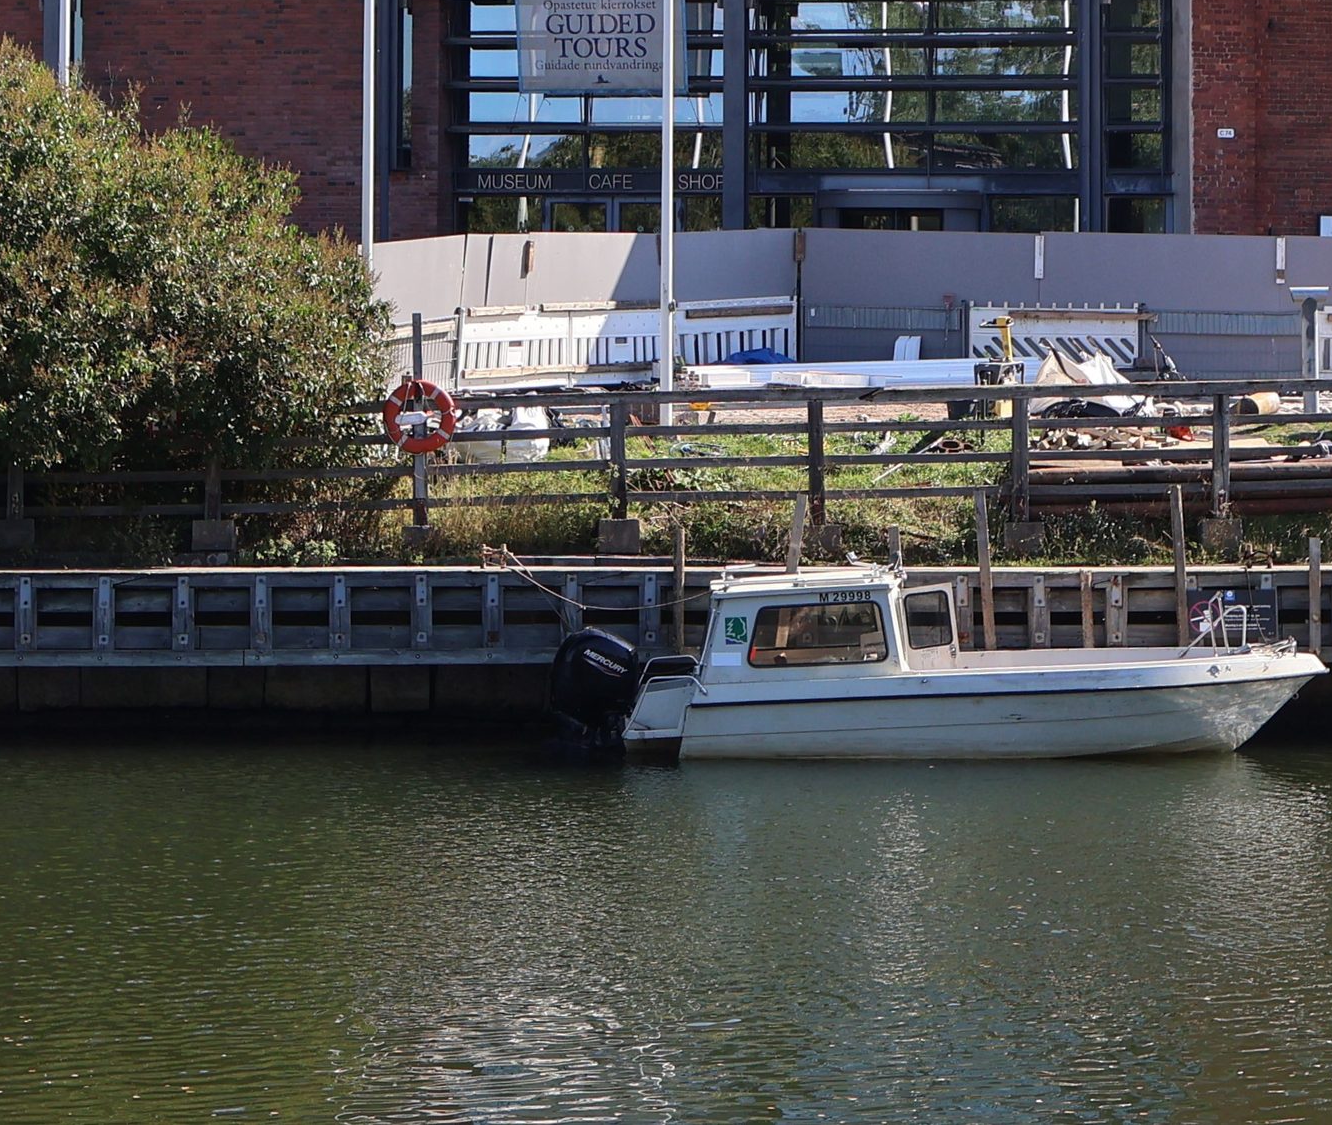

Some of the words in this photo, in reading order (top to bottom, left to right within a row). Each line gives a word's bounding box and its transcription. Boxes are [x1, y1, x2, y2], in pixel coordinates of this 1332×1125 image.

[543, 0, 597, 12] Opastetut
[546, 13, 656, 34] GUIDED
[554, 37, 647, 58] TOURS
[535, 59, 580, 71] Guidade
[477, 174, 552, 190] MUSEUM
[588, 174, 633, 190] CAFE
[819, 592, 829, 603] M
[832, 590, 872, 602] 29998
[583, 648, 628, 674] MERCURY
